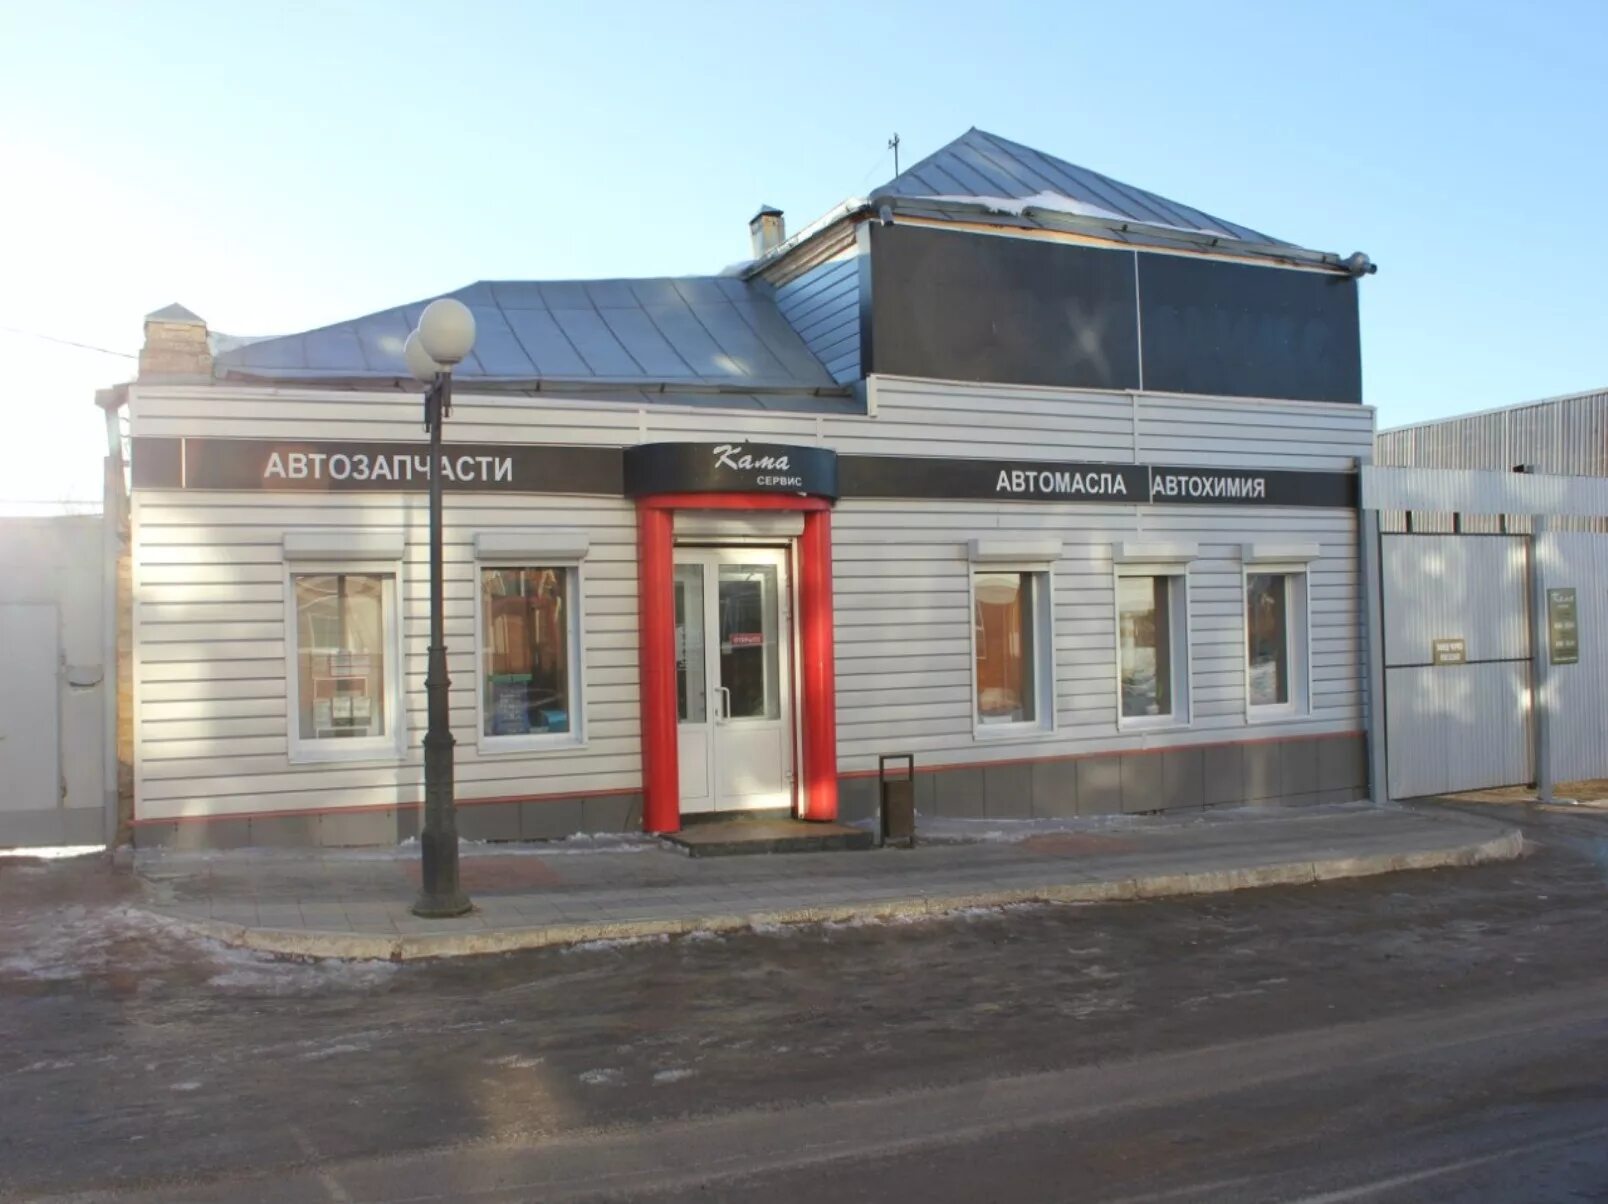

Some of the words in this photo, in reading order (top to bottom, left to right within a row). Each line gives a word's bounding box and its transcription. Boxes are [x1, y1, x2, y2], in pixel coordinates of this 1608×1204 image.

[263, 452, 512, 481] АВТОЗАПЧАСТИ
[713, 444, 790, 470] Кама
[757, 476, 802, 486] СЕРВИС
[996, 470, 1127, 494] АВТОМАСЛА
[1152, 475, 1265, 497] АВТОХИМИЯ
